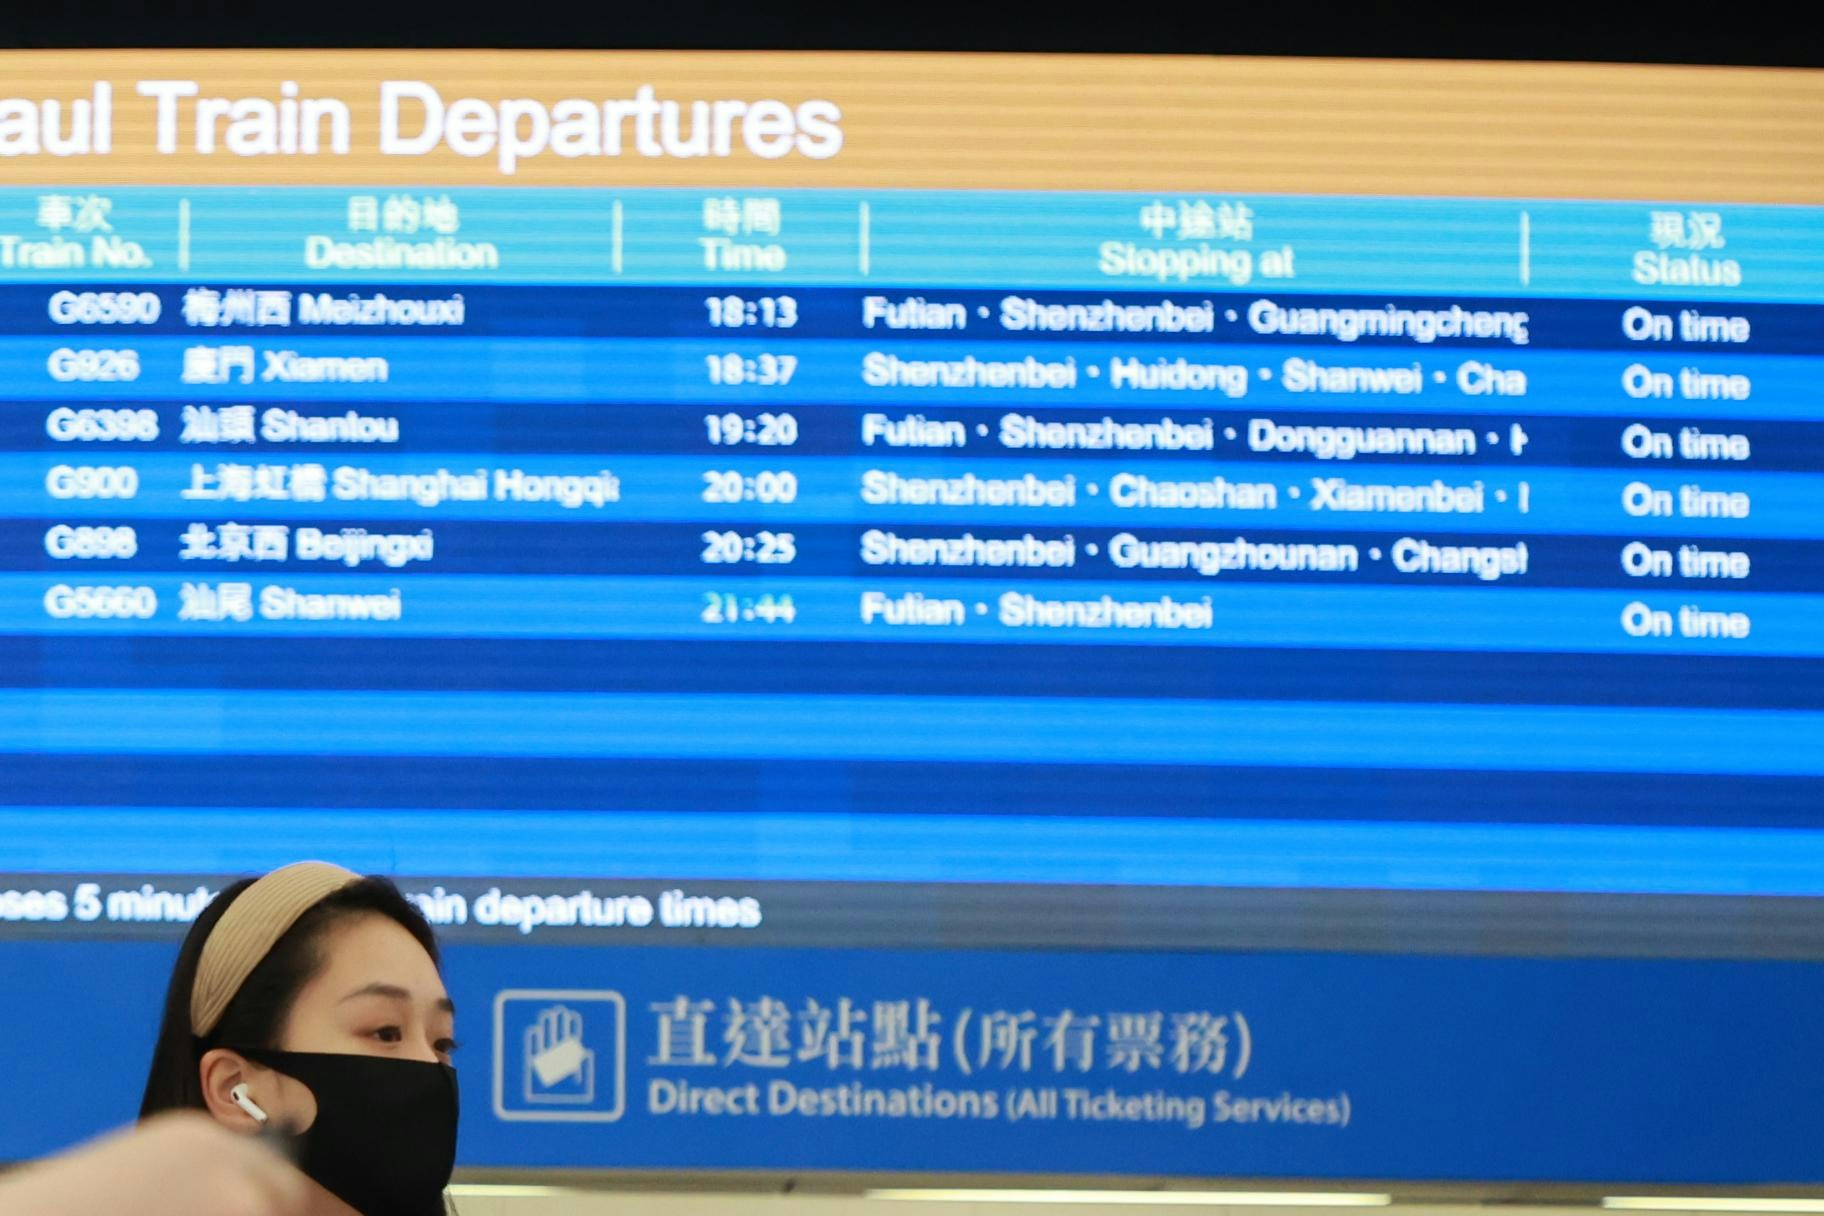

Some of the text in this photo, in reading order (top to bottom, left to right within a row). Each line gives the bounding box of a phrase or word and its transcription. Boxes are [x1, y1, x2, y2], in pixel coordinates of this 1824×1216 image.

[137, 81, 352, 157] Train
[380, 82, 844, 176] Departures
[92, 237, 153, 268] No.
[305, 235, 500, 269] Destination
[700, 238, 789, 272] Time
[1100, 241, 1294, 285] Stopping at
[1634, 248, 1742, 286] Status
[708, 297, 798, 328] 18:13
[865, 298, 967, 329] Futian
[1002, 297, 1215, 333] Shenzhenbei
[1624, 308, 1751, 343] On time
[48, 349, 141, 382] G926
[262, 349, 389, 382] Xiamen
[864, 353, 1078, 389] Shenzhenbei
[1112, 358, 1249, 398] Huidong
[1284, 359, 1424, 394] Shanwei
[1624, 365, 1751, 401] On time
[707, 414, 798, 446] 19:20
[864, 415, 966, 447] Futian
[1001, 414, 1214, 450] Shenzhenbei
[1250, 420, 1477, 460] Dongguannan
[1624, 425, 1751, 460] On time
[47, 466, 139, 500] G900
[333, 466, 487, 506] Shanghai
[703, 472, 798, 504] 20:00
[862, 471, 1076, 507] Shenzhenbei
[1312, 479, 1484, 513] Xiamenbei
[1624, 483, 1750, 519] On time
[296, 524, 434, 566] Beijingxi
[863, 531, 1076, 567] Shenzhenbei
[1111, 534, 1359, 576] Guangzhounan
[1623, 543, 1751, 579] On time
[862, 592, 1214, 629] Futian Shenzhenbei
[1622, 603, 1751, 639] On time
[74, 884, 100, 920] 5
[475, 889, 653, 932] departure
[659, 890, 764, 928] times
[648, 1078, 1353, 1130] Direct Destinations (All Ticketing Services)
